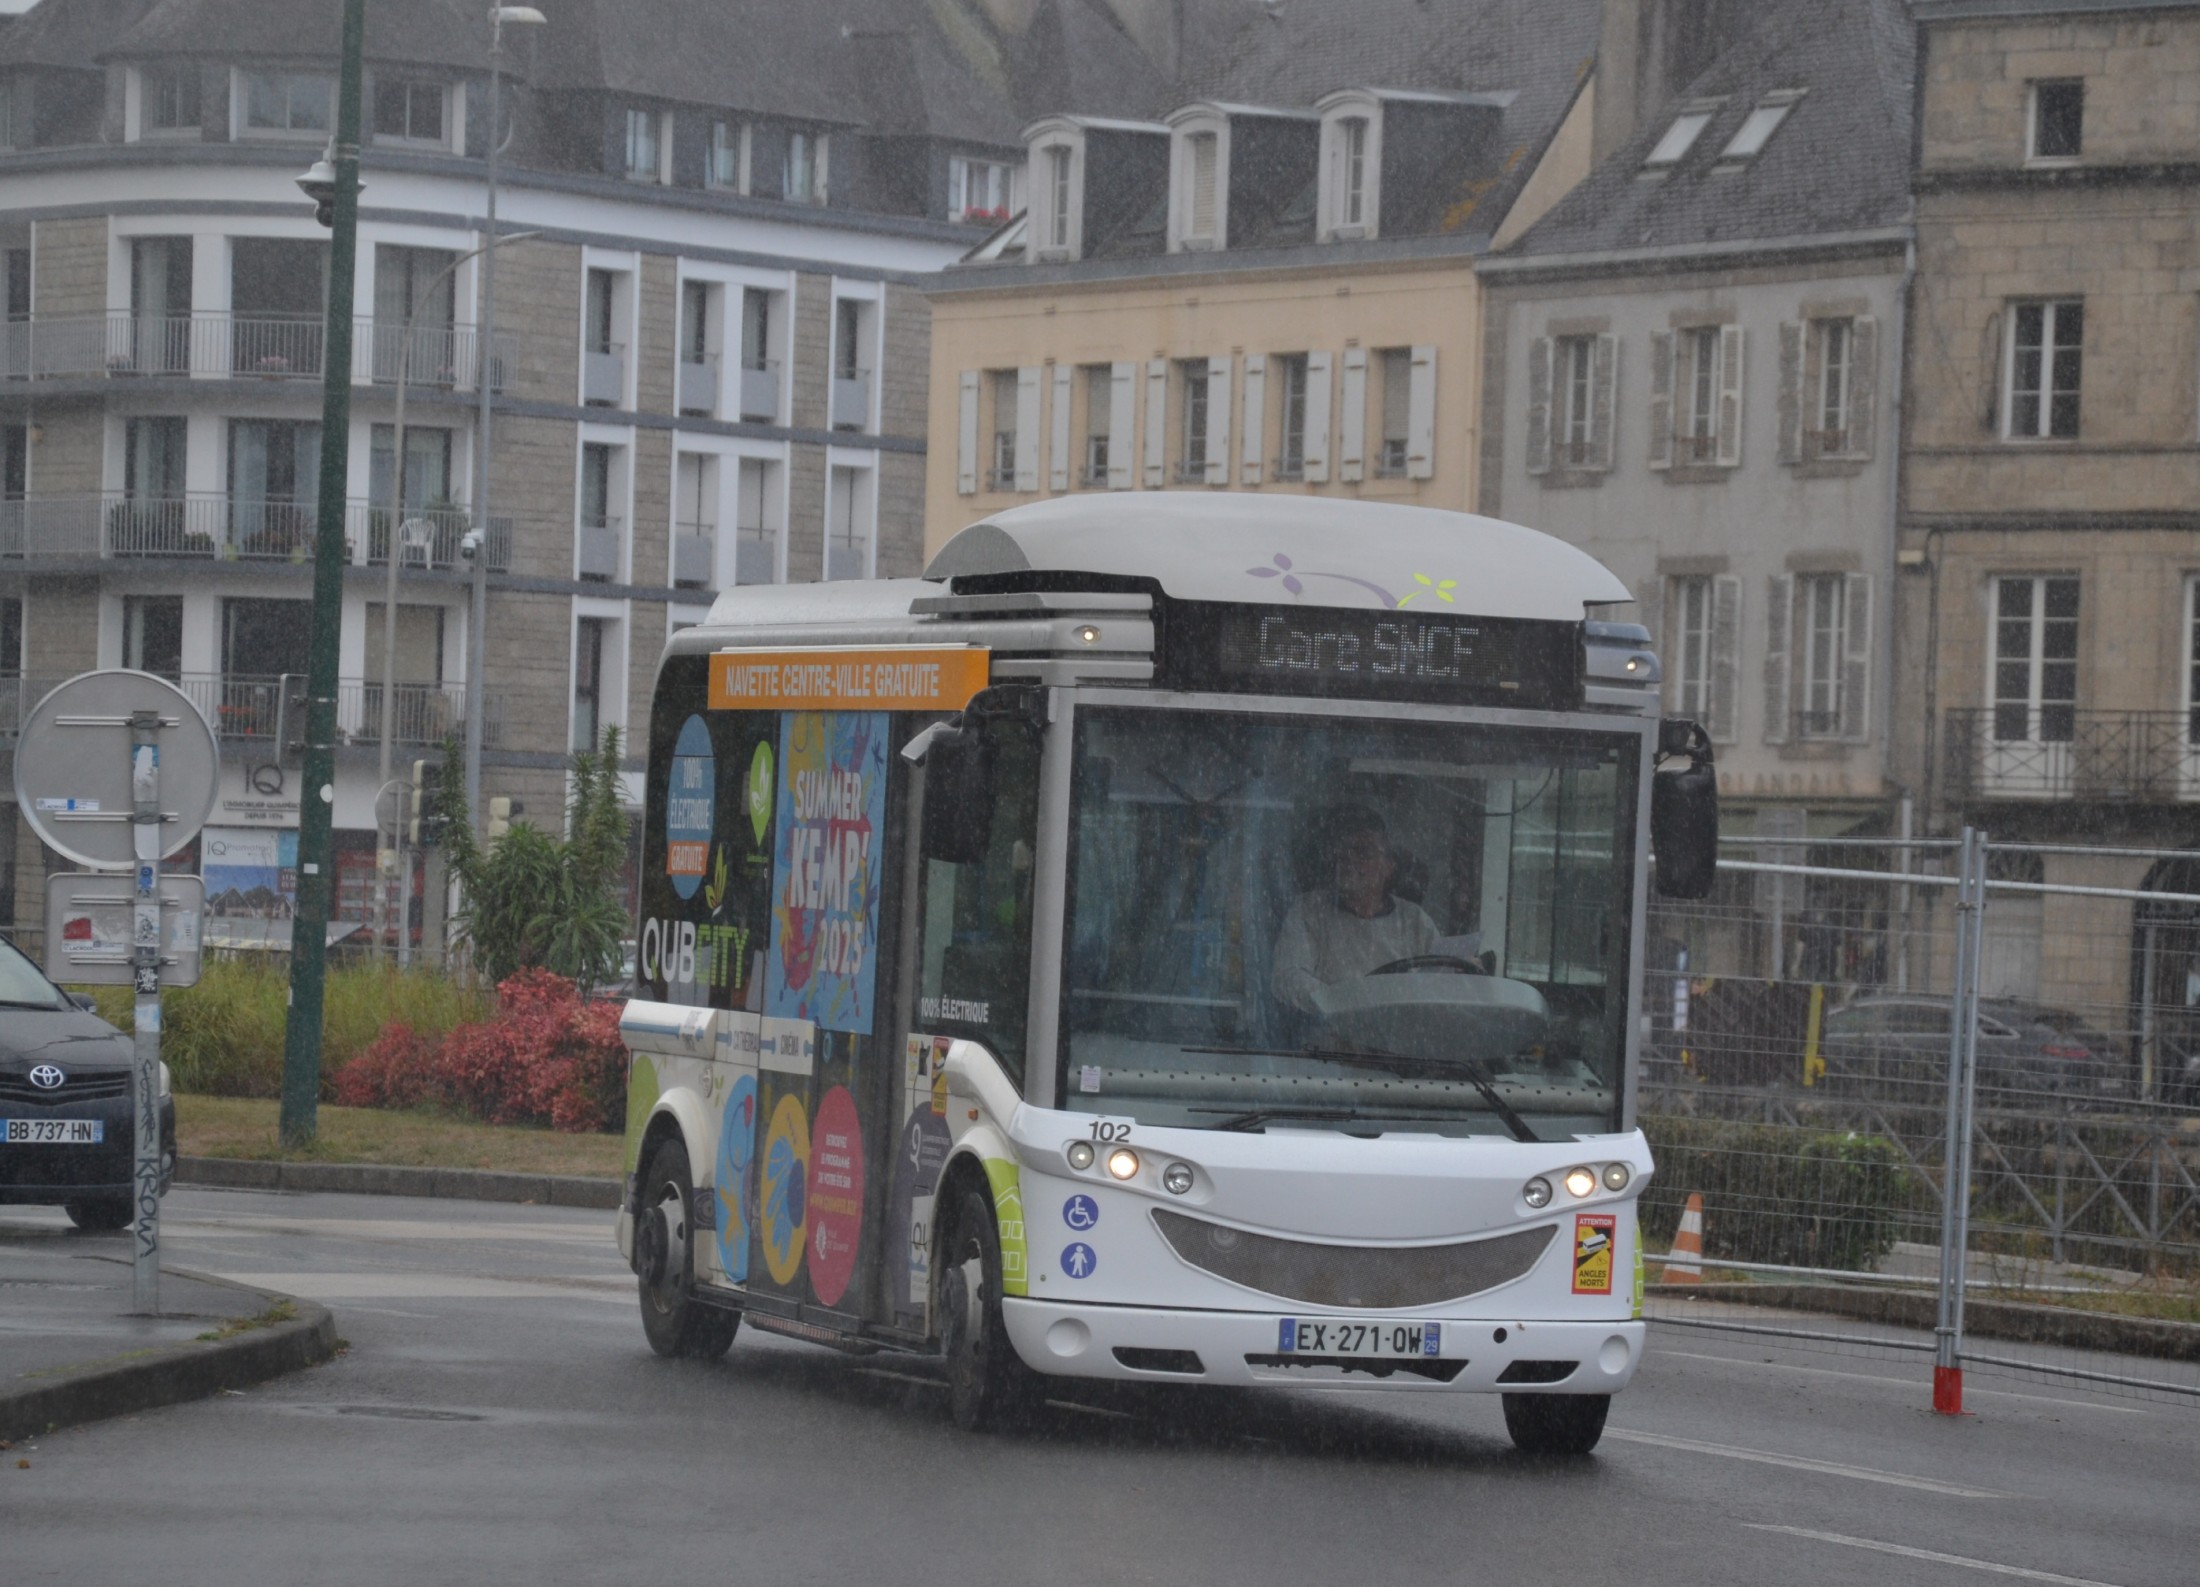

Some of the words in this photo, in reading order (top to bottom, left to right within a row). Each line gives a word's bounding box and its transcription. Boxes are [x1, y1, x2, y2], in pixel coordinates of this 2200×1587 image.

[1259, 615, 1360, 672] Gare
[1373, 622, 1479, 677] SNCF
[726, 664, 779, 697] NAVETTE
[782, 664, 871, 697] CENTRE-VILLE
[875, 663, 939, 697] GRATUITE
[245, 763, 283, 795] IQ
[683, 757, 703, 789] 100%
[794, 770, 863, 822] SUMMER
[244, 811, 268, 820] DEPUIS
[669, 792, 711, 831] ÉLECTRIQUE
[670, 845, 704, 872] GRATUITE
[818, 918, 864, 974] 2025
[919, 997, 940, 1018] 100%
[941, 997, 989, 1024] ÉLECTRIQUE
[8, 1121, 92, 1141] BB-737-HN
[1088, 1121, 1132, 1143] 102
[1579, 1217, 1613, 1226] ATTENTION
[1579, 1270, 1607, 1279] ANGLES
[1579, 1279, 1605, 1287] MORTS
[1425, 1339, 1439, 1353] 29
